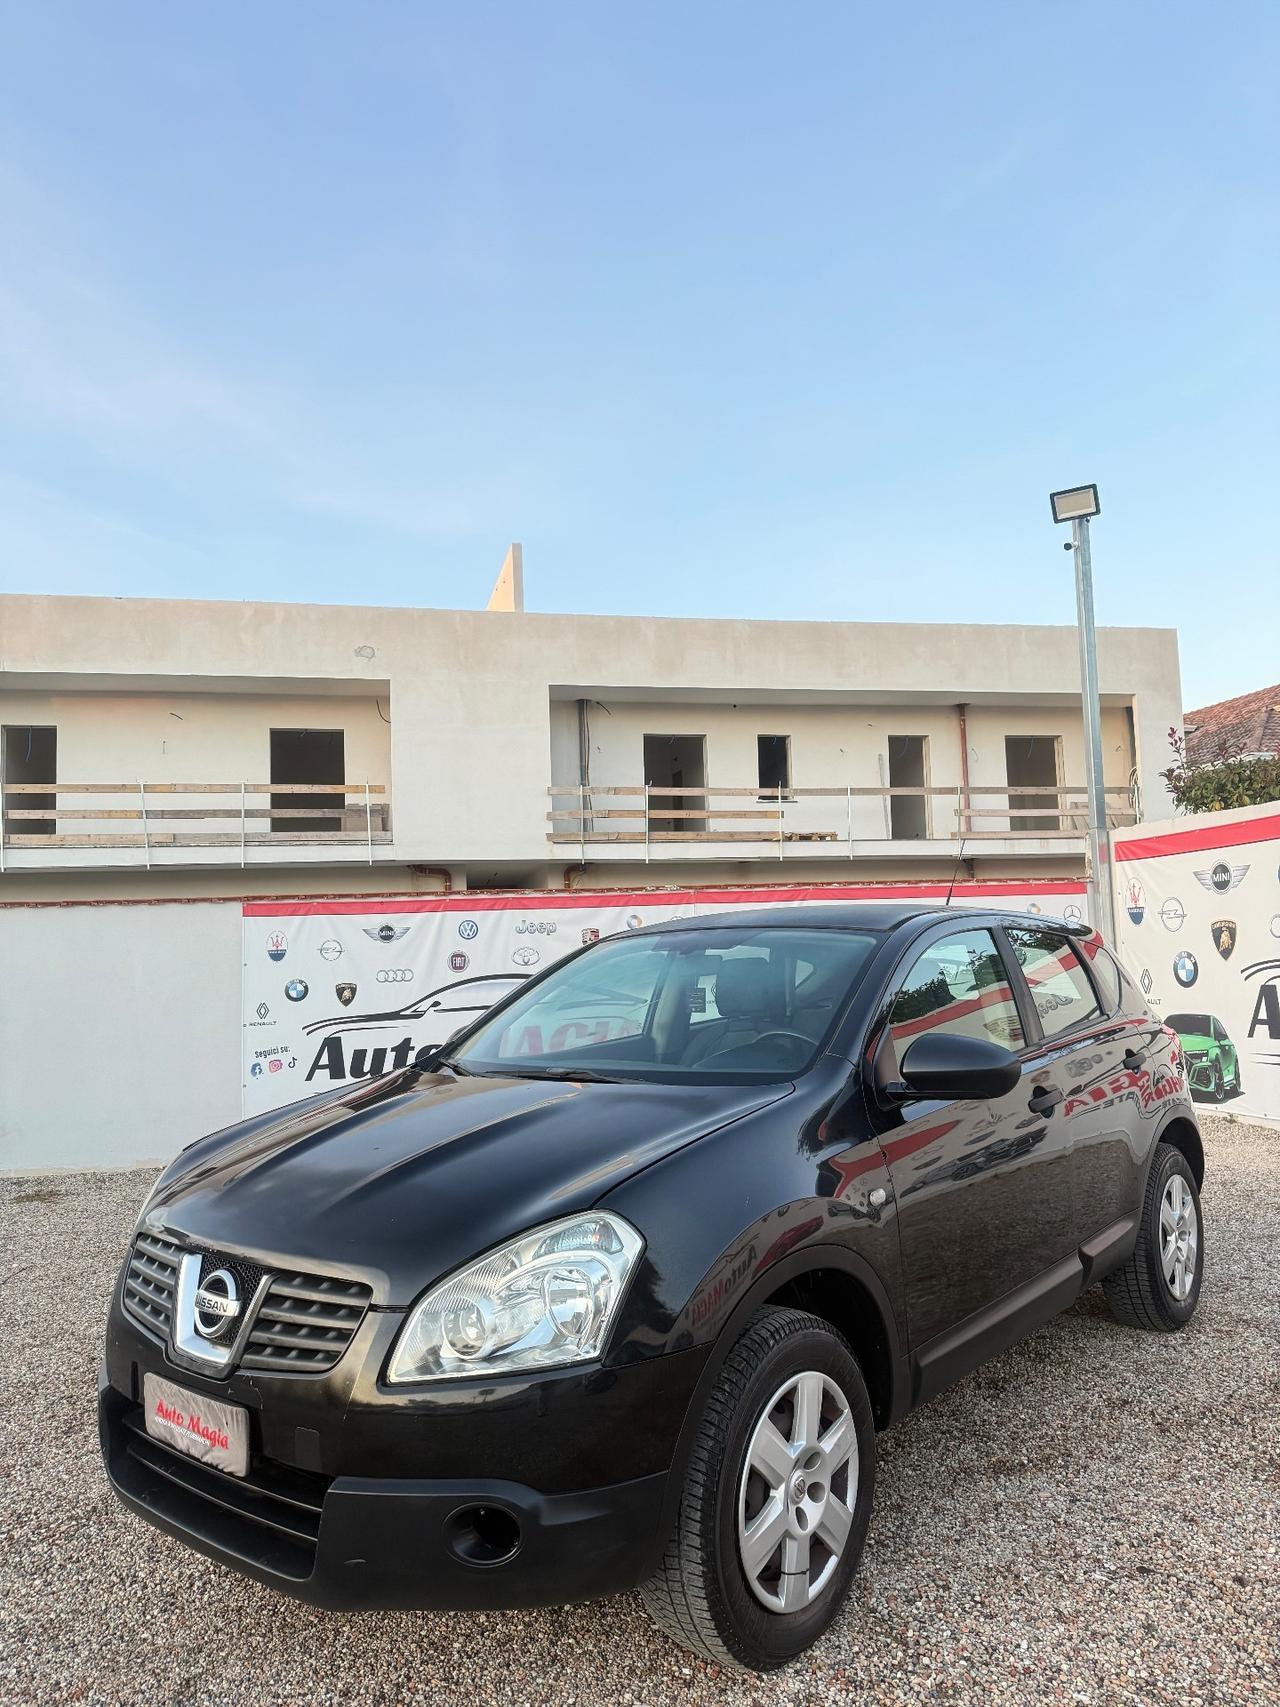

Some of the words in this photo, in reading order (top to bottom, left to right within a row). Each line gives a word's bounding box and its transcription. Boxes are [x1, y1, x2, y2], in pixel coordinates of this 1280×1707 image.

[1213, 872, 1231, 882] MINI
[379, 928, 395, 936] MINI
[515, 920, 557, 935] Jeep
[452, 956, 466, 968] FIAT
[254, 1046, 279, 1059] Seguici
[194, 1294, 229, 1313] NISSAN
[155, 1398, 184, 1426] Auto
[187, 1414, 229, 1449] Magia
